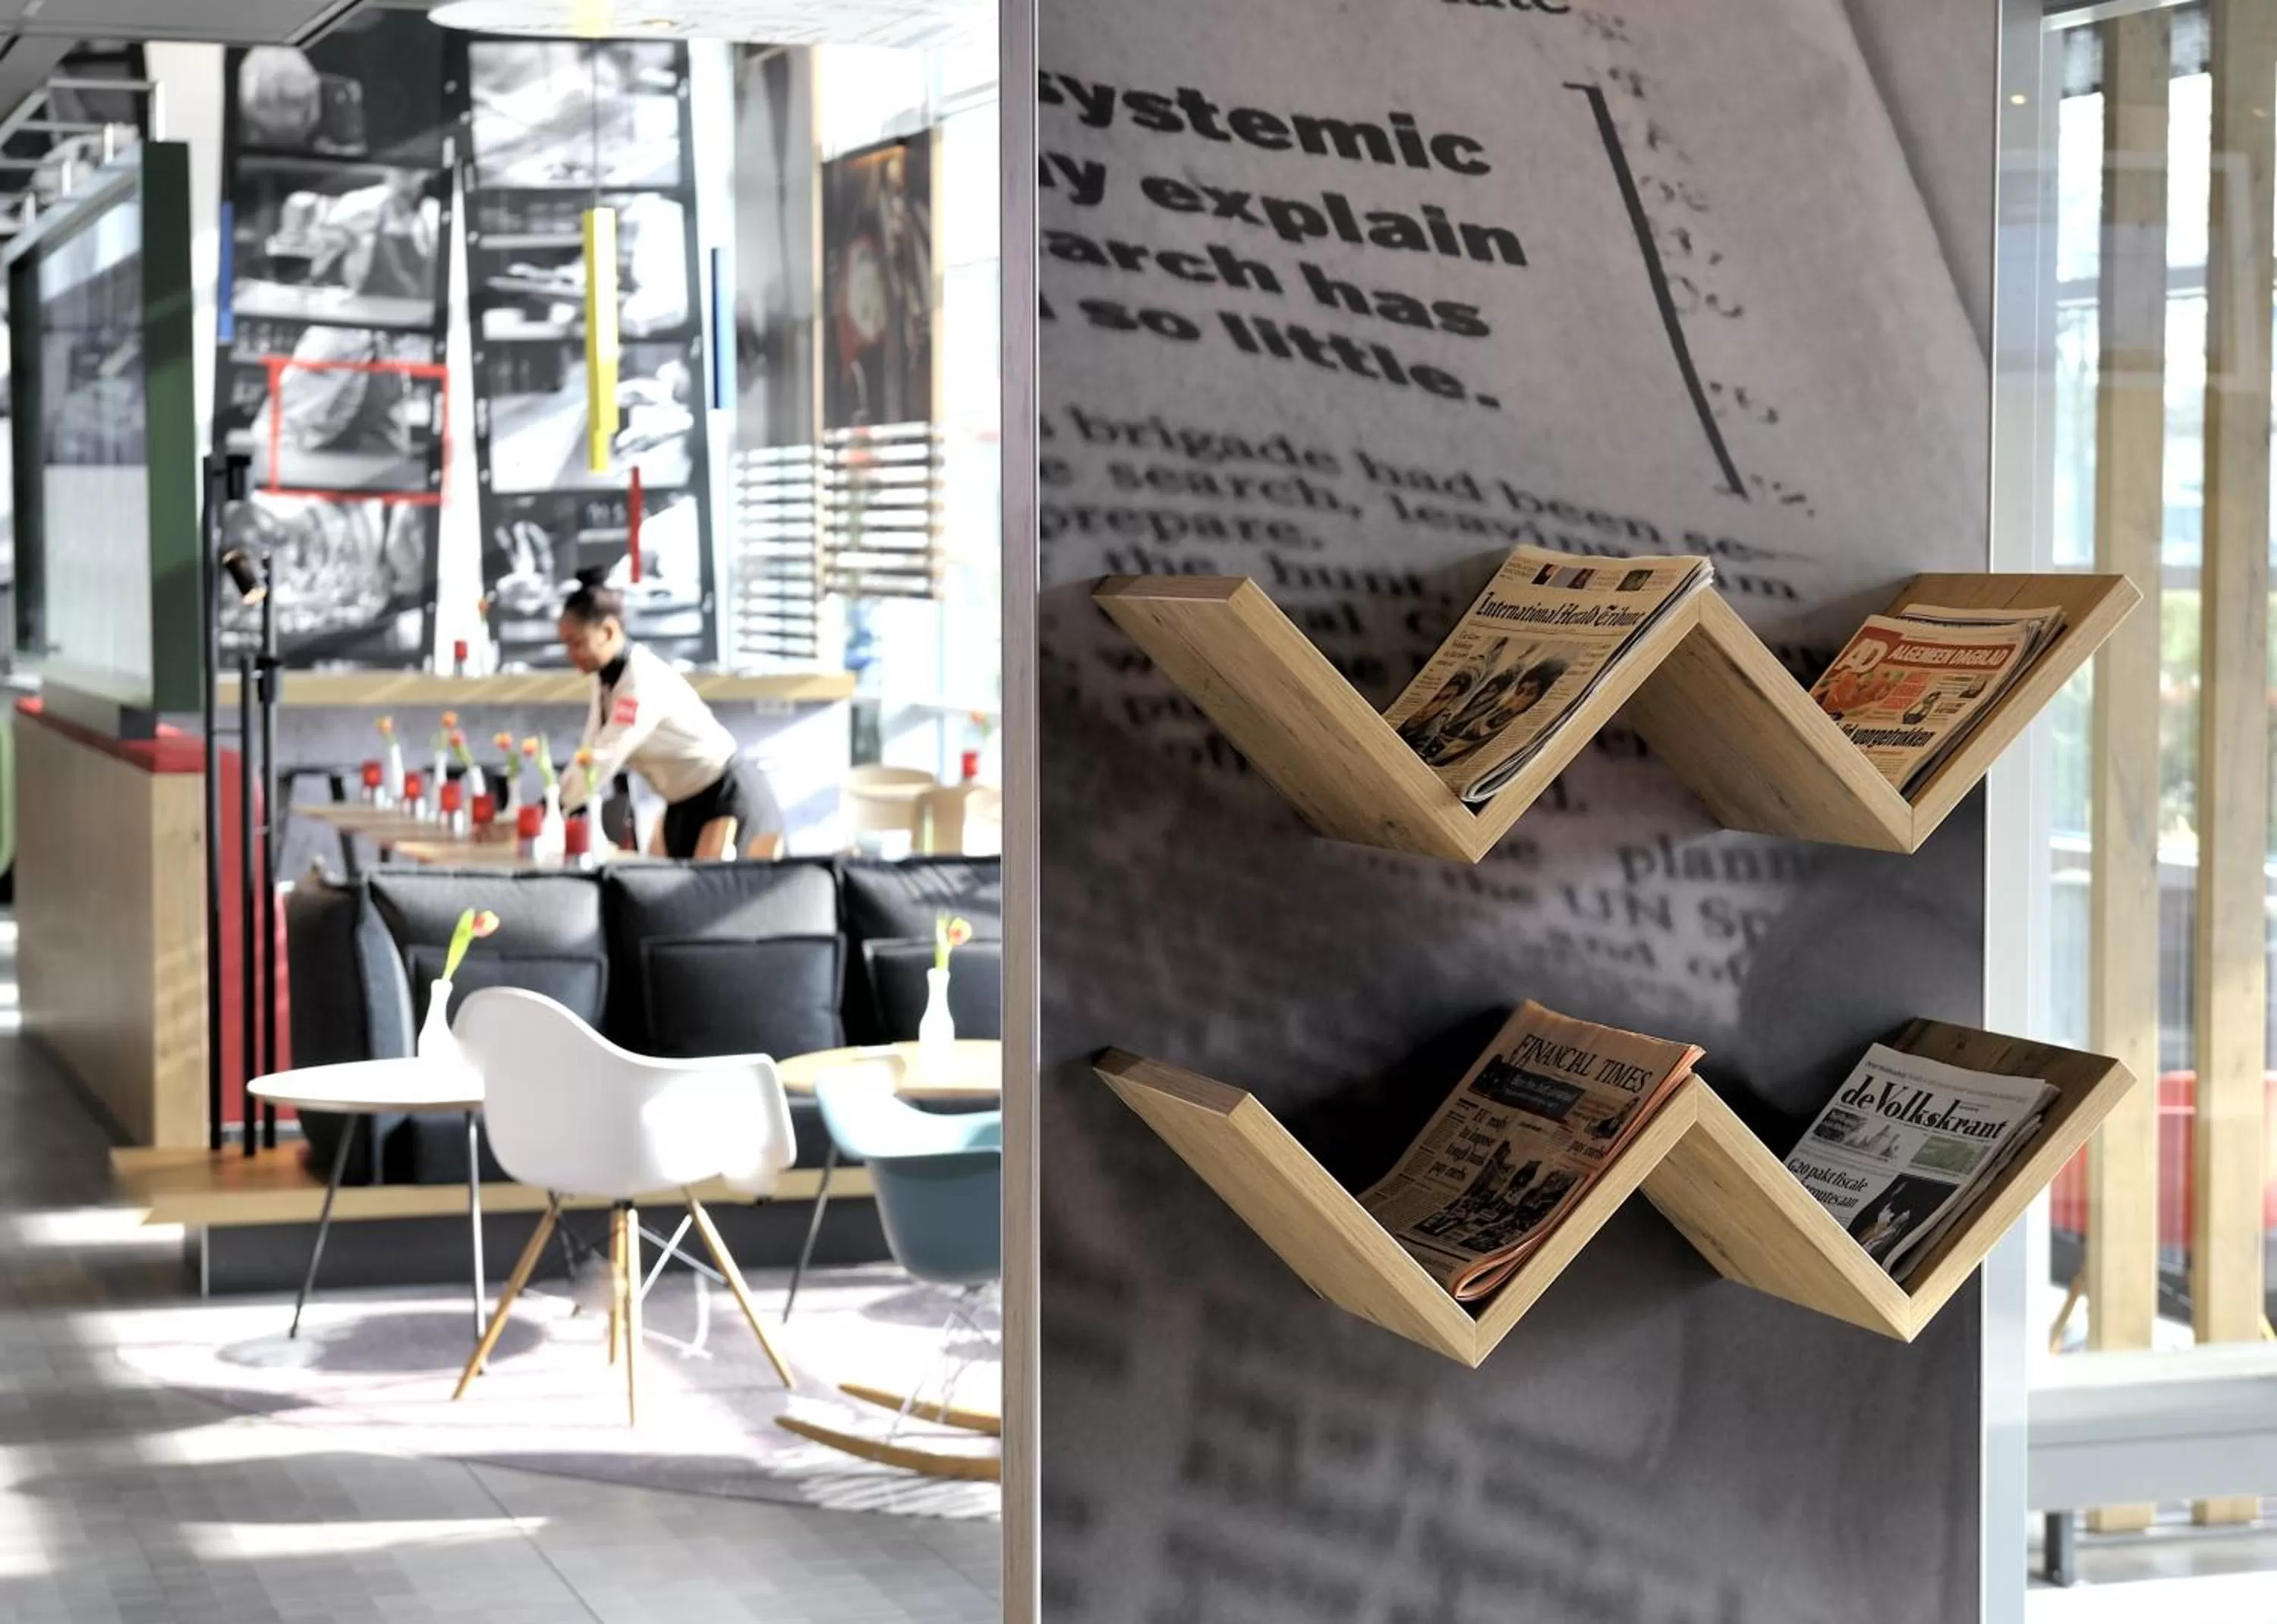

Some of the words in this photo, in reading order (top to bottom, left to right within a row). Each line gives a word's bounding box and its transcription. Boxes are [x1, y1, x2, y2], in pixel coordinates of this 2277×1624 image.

[1140, 175, 1529, 267] explain
[1299, 261, 1491, 338] has
[1077, 298, 1201, 342] so
[1219, 310, 1501, 410] little.
[1069, 402, 1340, 477] brigade
[1350, 449, 1483, 502] had
[1495, 477, 1662, 544] been
[1475, 591, 1567, 625] International
[1834, 637, 1890, 674] AD
[1888, 644, 1954, 666] ALGEMEEN
[1948, 647, 2011, 666] DAGBLAD
[1510, 1033, 1598, 1077] FINANCIAL
[1593, 1058, 1654, 1094] TIMES
